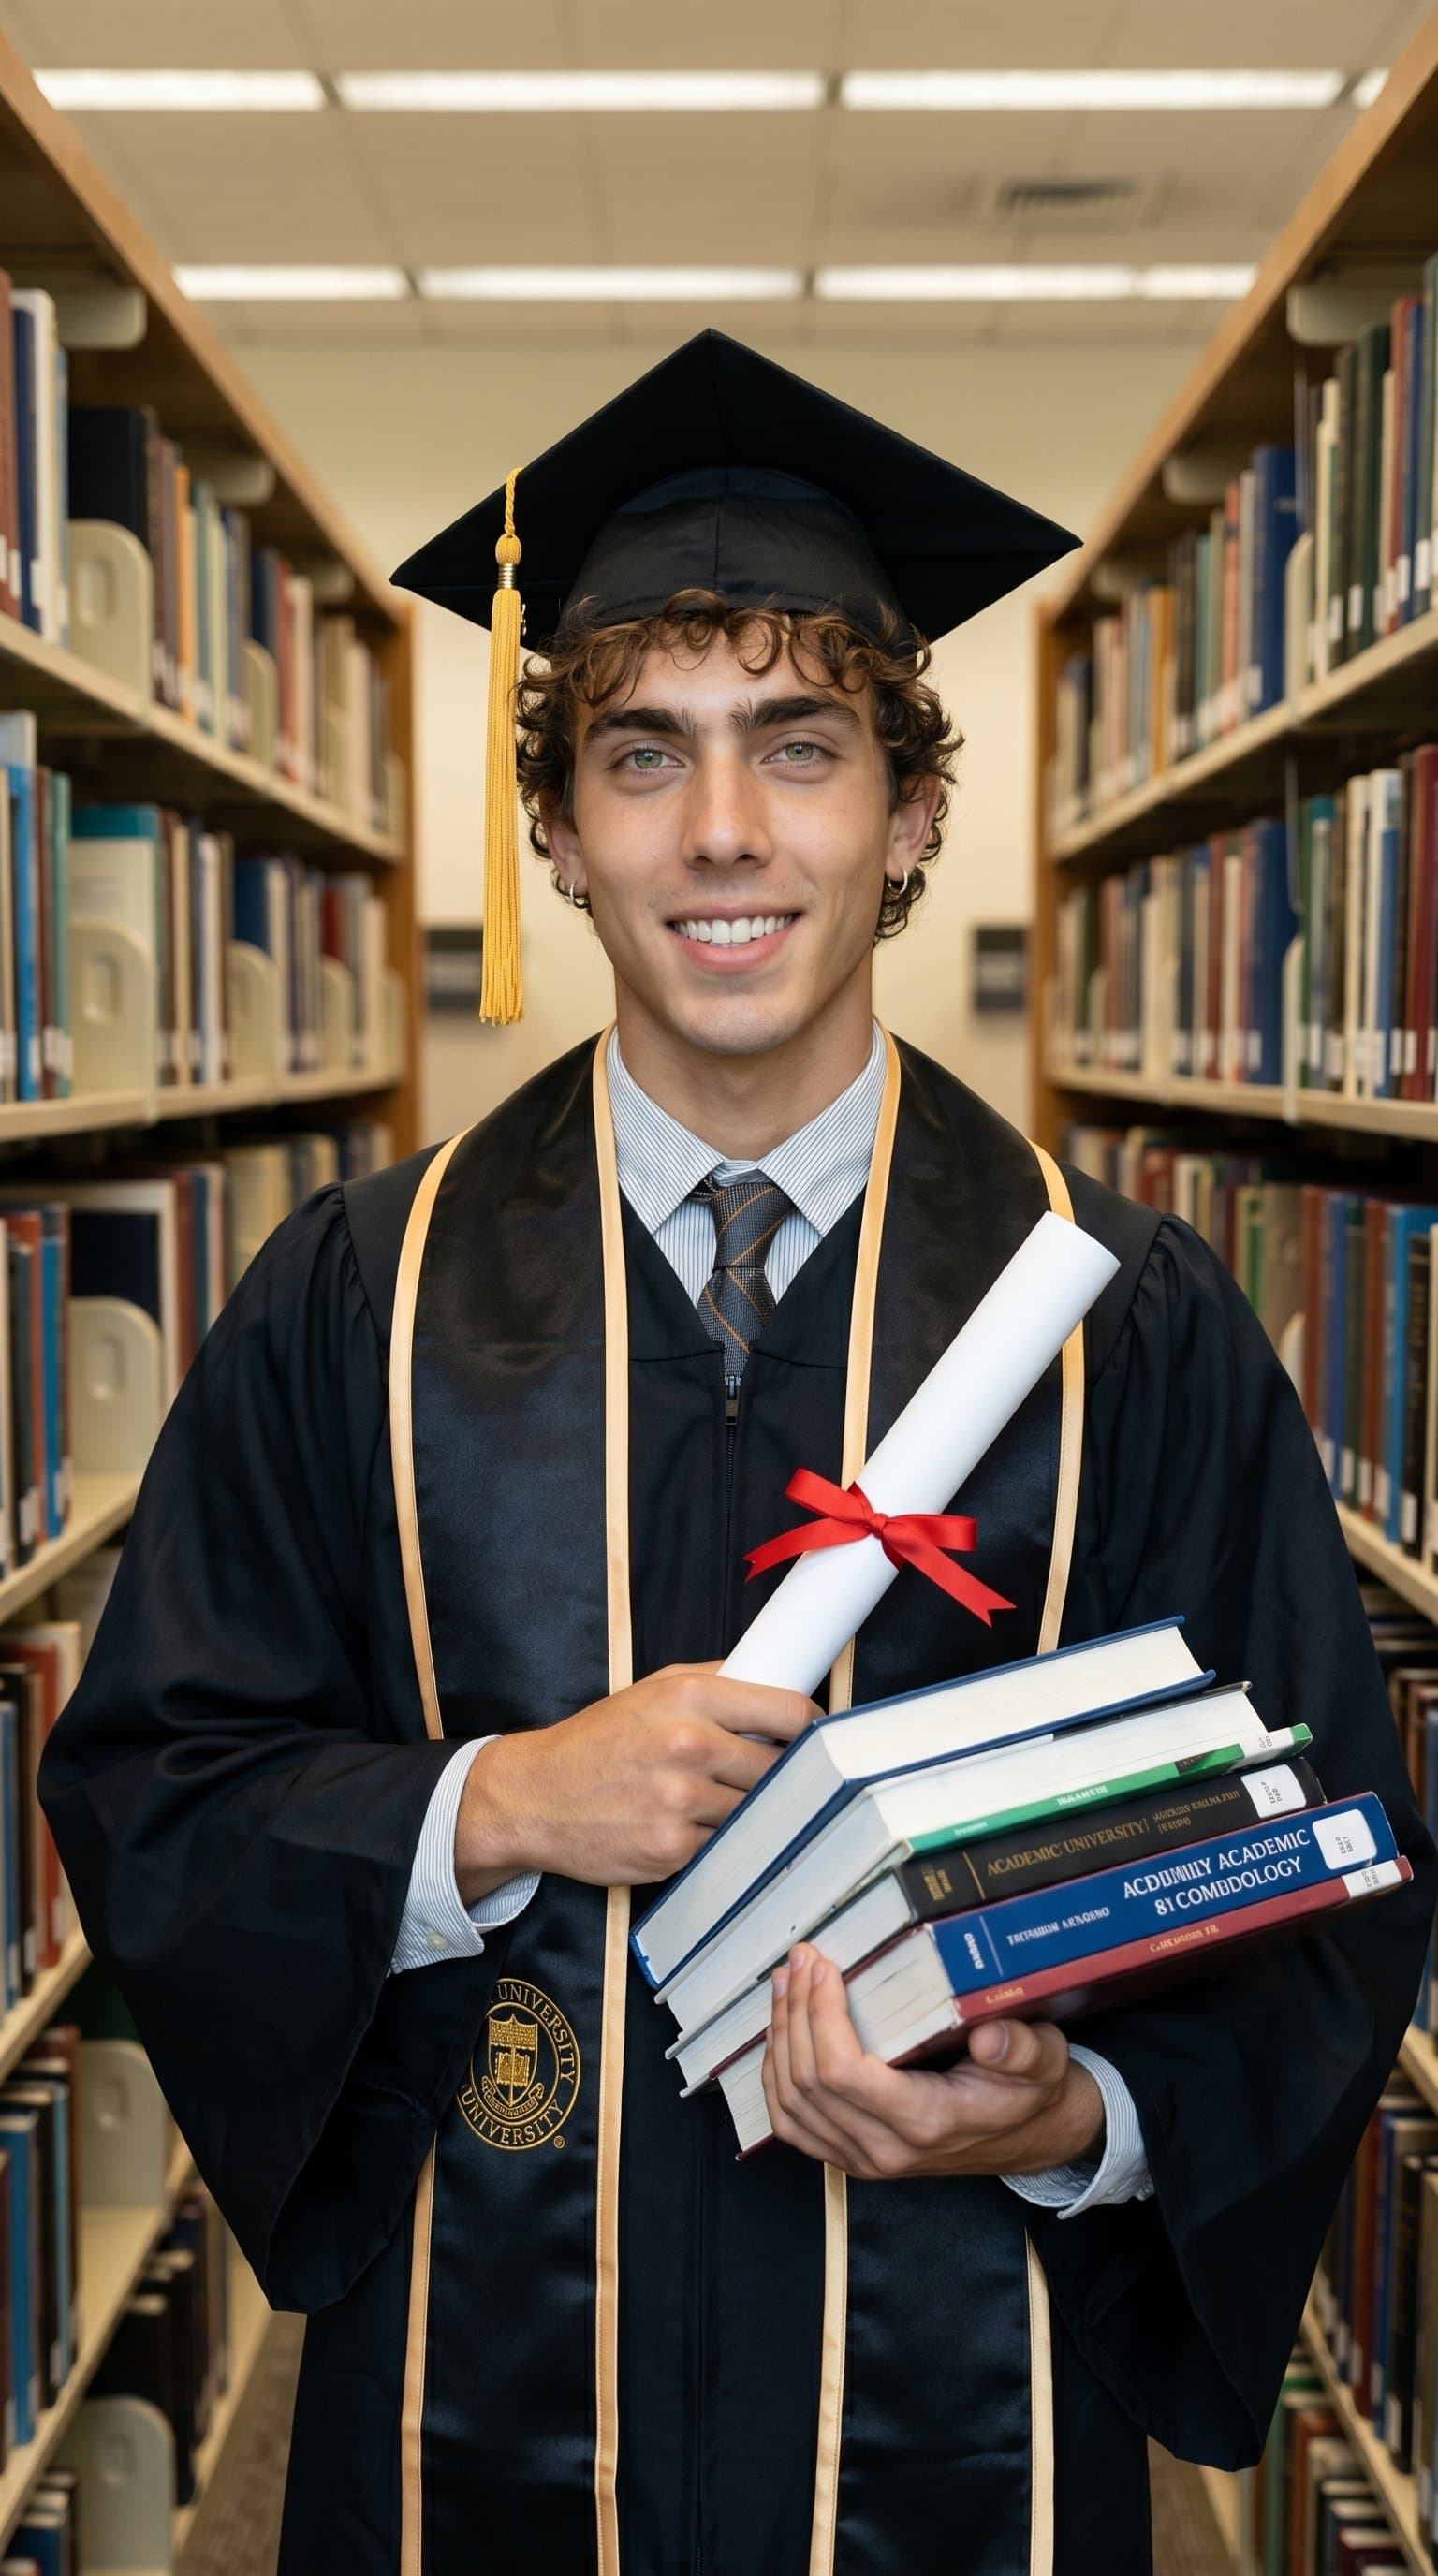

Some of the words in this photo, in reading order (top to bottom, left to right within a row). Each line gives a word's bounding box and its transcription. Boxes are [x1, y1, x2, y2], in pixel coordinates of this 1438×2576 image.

[987, 1842, 1062, 1877] ACADEMIC
[1218, 1829, 1311, 1871] ACADEMIC
[497, 1983, 575, 2085] UNIVERSITY
[462, 2086, 563, 2144] UNIVERSITY
